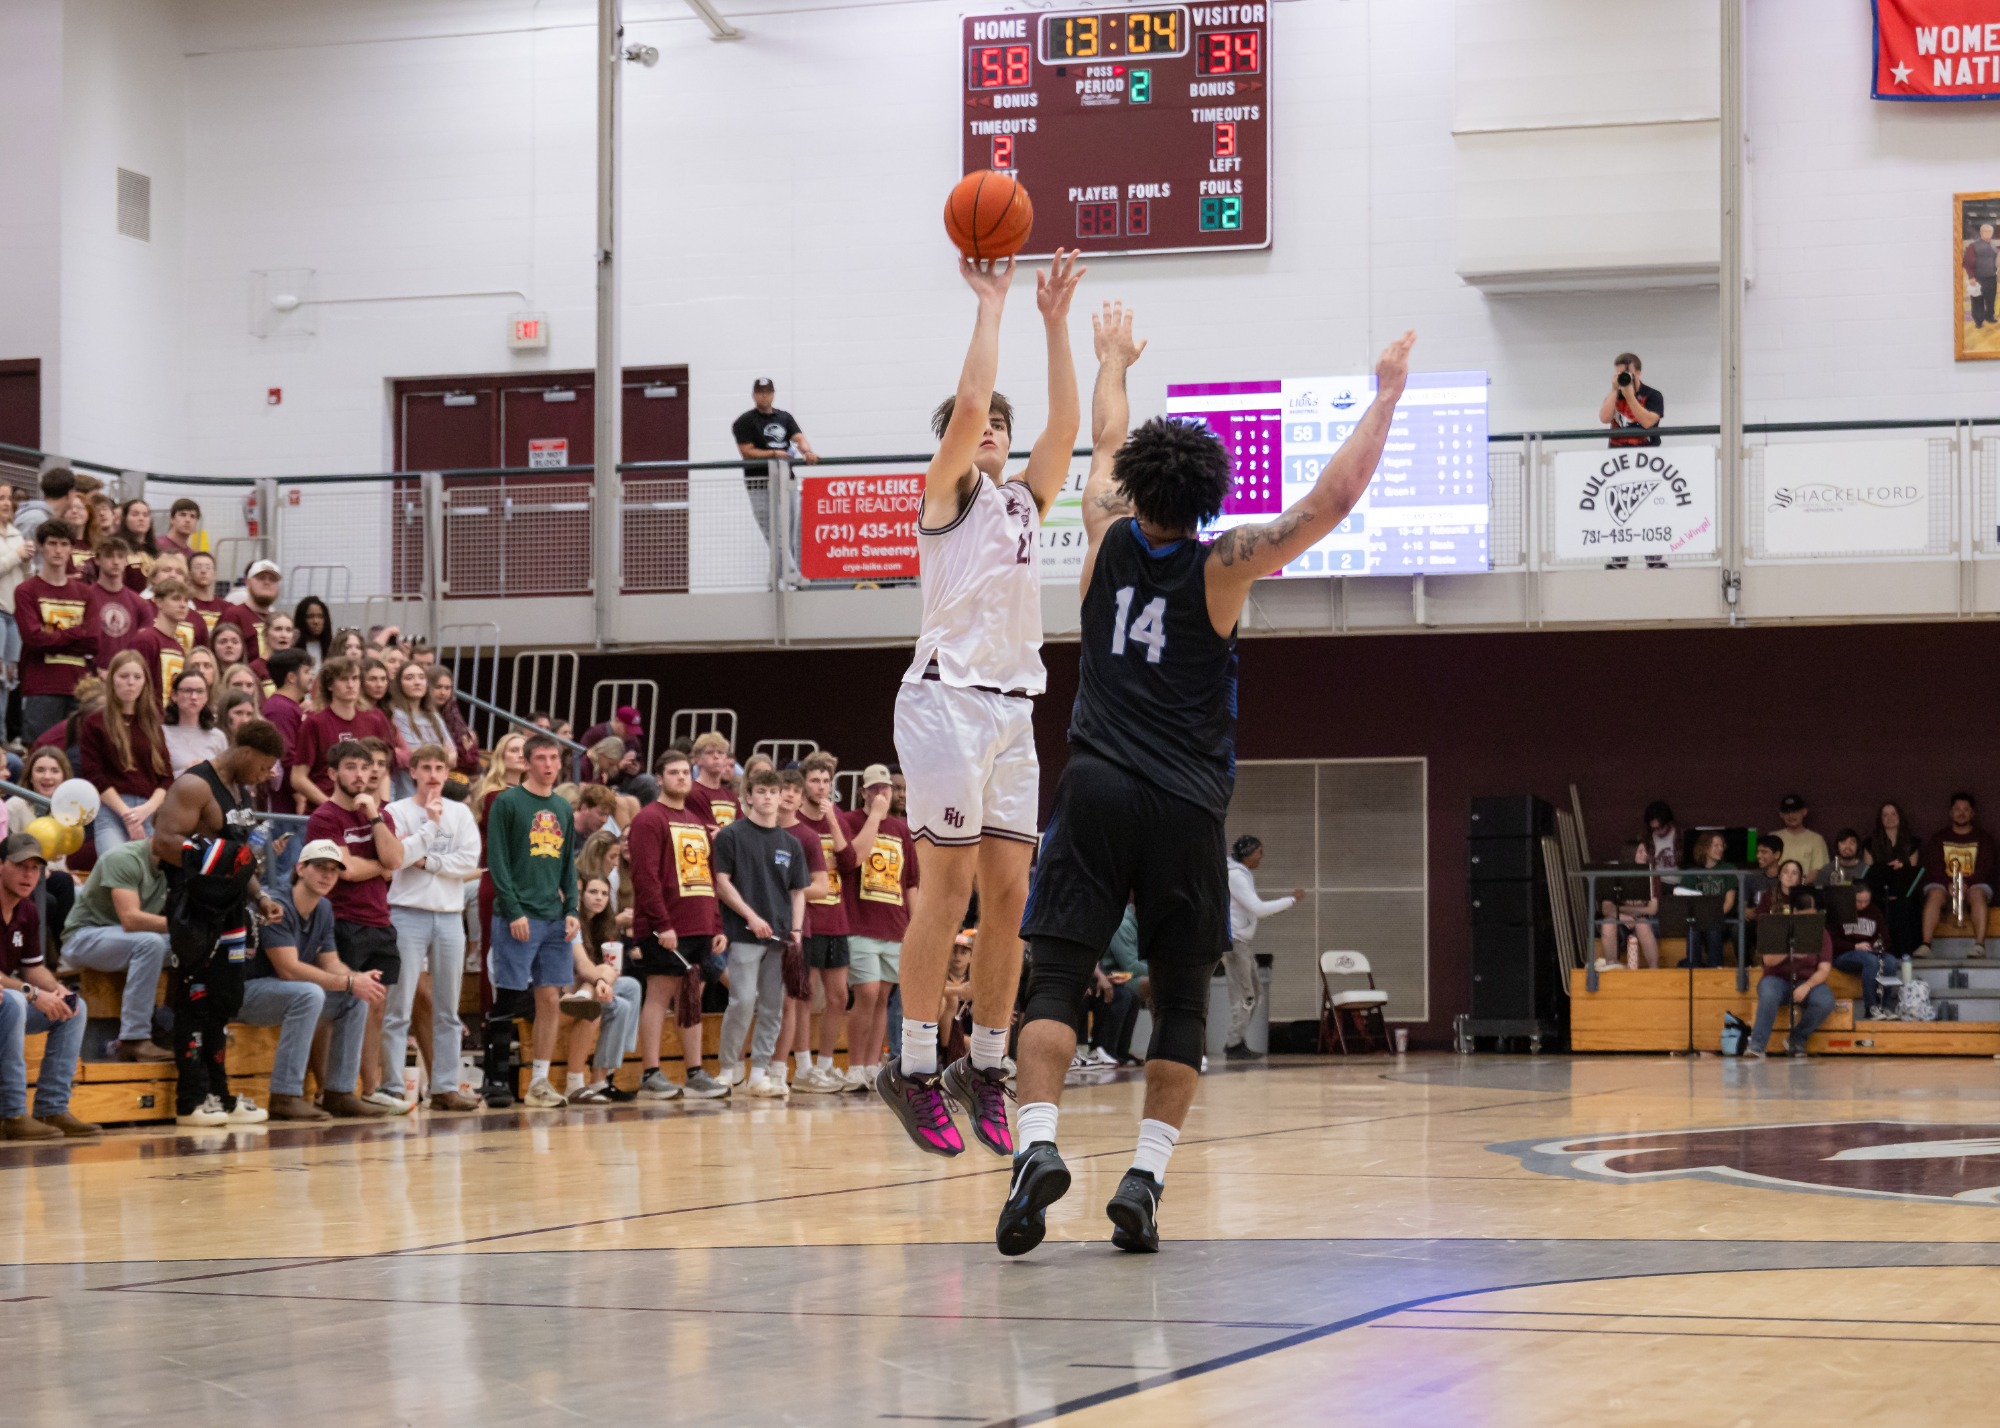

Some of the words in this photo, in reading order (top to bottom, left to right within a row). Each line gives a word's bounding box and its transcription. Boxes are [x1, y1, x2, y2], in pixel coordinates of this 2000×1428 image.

[1193, 5, 1265, 26] VISITOR
[974, 20, 1026, 40] HOME
[1065, 10, 1177, 57] 13:04
[1209, 34, 1257, 74] 34
[981, 46, 1029, 87] 58
[1086, 65, 1113, 78] POSS
[1075, 78, 1124, 94] PERIOD
[1131, 71, 1150, 102] 2
[1190, 81, 1235, 97] BONUS
[993, 93, 1038, 109] BONUS
[1191, 106, 1260, 123] TIMEOUTS
[970, 118, 1037, 135] TIMEOUTS
[1216, 123, 1233, 156] 3
[993, 137, 1011, 168] 2
[1209, 157, 1242, 172] LEFT
[1068, 186, 1118, 201] PLAYER
[1128, 183, 1171, 199] FOULS
[1200, 180, 1242, 195] FOULS
[515, 320, 539, 340] EXIT
[1293, 425, 1313, 441] 58
[827, 480, 866, 497] CRYE
[1579, 454, 1630, 511] DULCIE
[1635, 453, 1692, 507] DOUGH
[817, 499, 851, 515] ELITE
[855, 496, 920, 513] REALTOR
[1772, 486, 1918, 509] SHACKELFORD
[815, 523, 855, 544] (731)
[827, 546, 858, 558] John
[861, 544, 917, 558] Sweeney
[842, 563, 902, 573] crye-leike.com
[1300, 554, 1310, 570] 4
[1341, 553, 1352, 569] 2
[1111, 585, 1167, 664] 14
[944, 807, 965, 828] FHU
